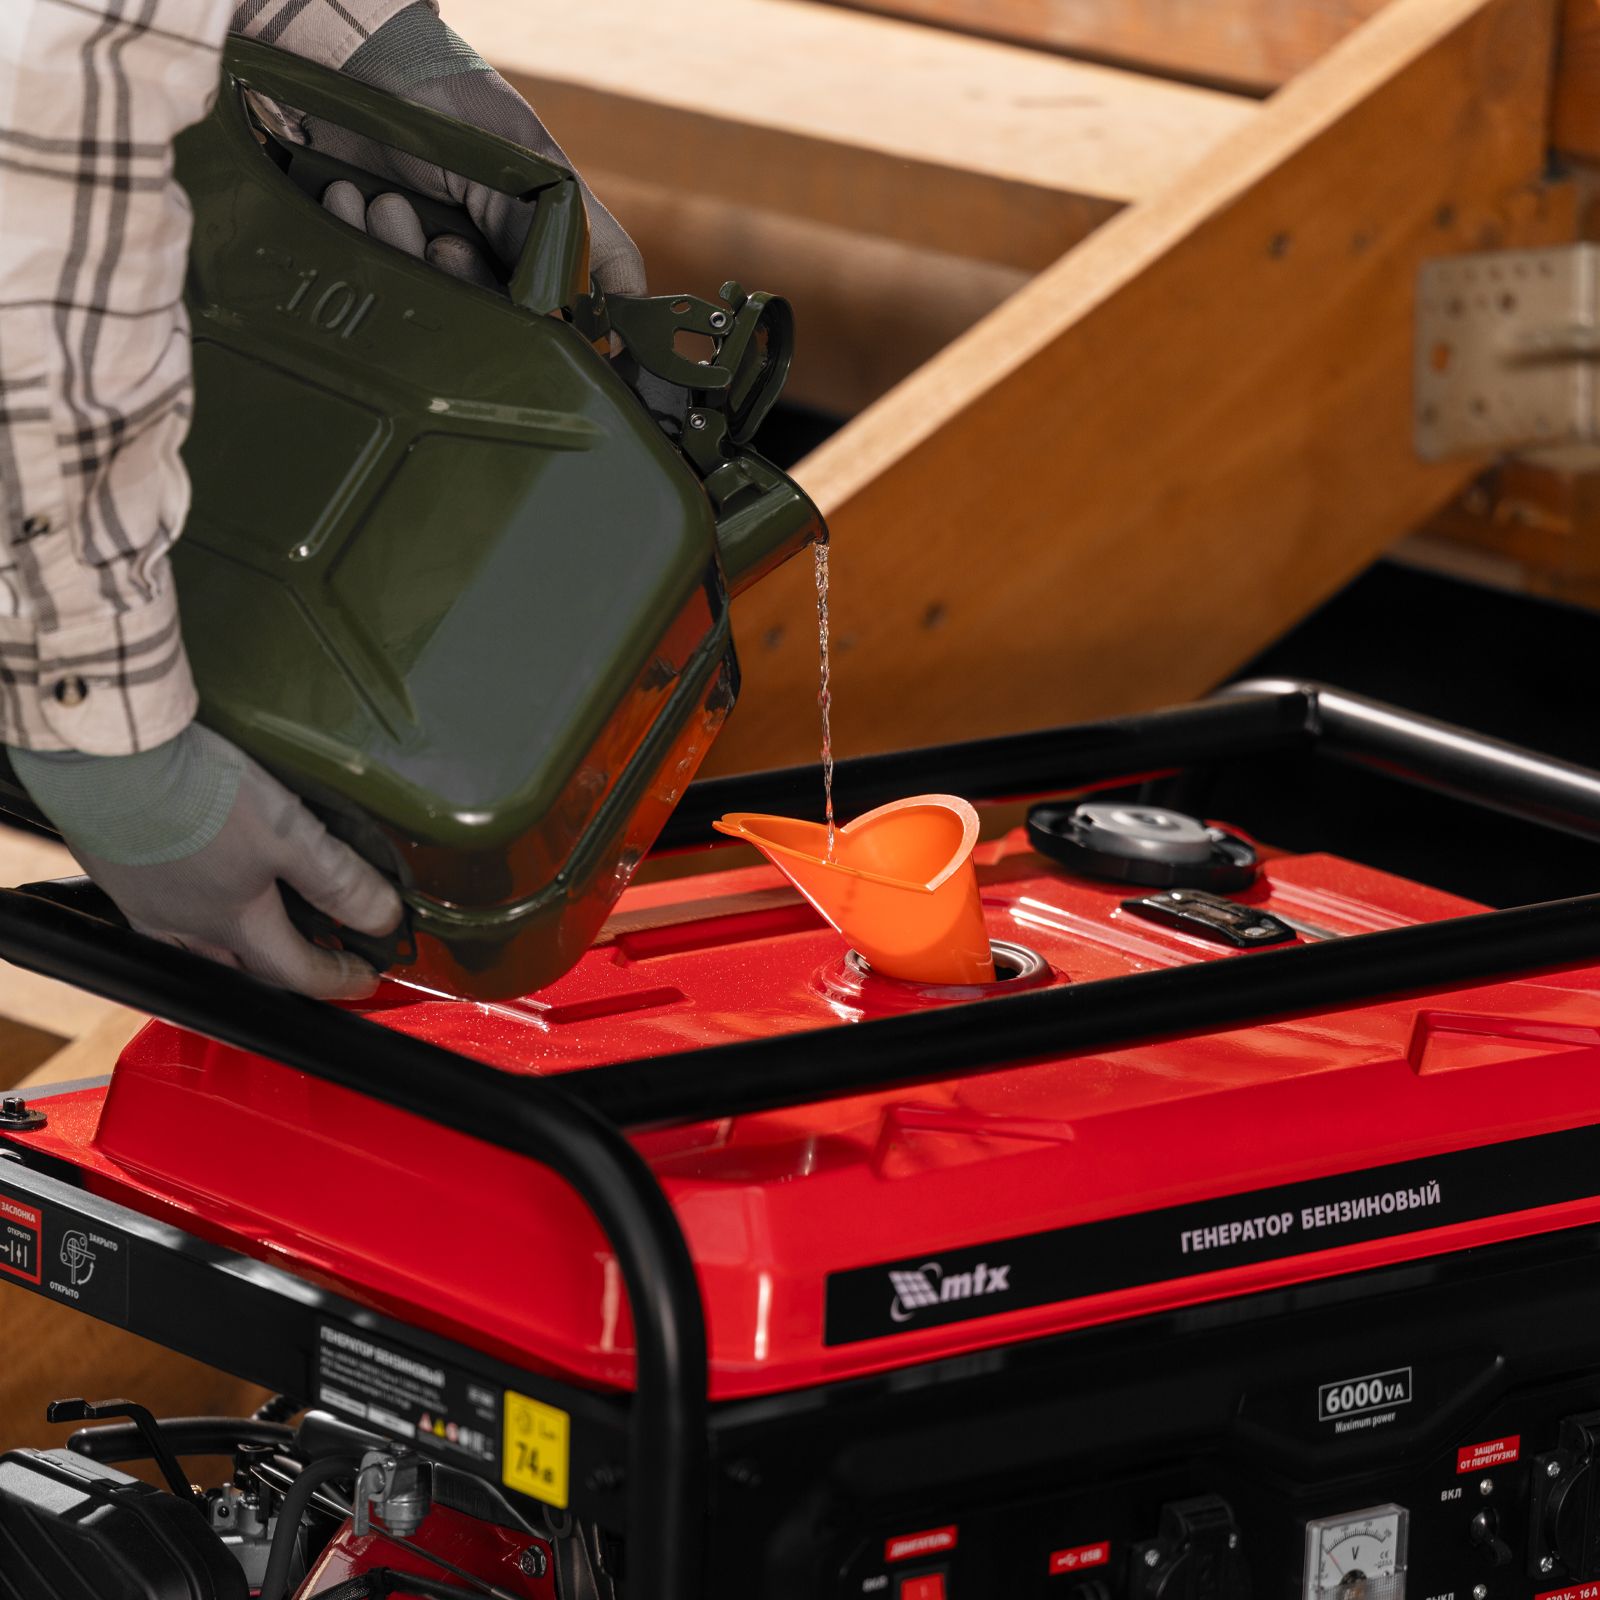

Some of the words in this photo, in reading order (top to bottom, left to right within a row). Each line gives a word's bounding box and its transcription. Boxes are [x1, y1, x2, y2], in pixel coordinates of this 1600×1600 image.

[0, 1201, 36, 1223] ЗАСЛОНКА
[1180, 1211, 1294, 1254] ГЕНЕРАТОР
[1301, 1180, 1441, 1230] БЕНЗИНОВЫЙ
[7, 1226, 31, 1241] ОТКРЫТО
[88, 1232, 118, 1252] ЗАКРЫТО
[49, 1281, 79, 1300] ОТКРЫТО
[938, 1262, 1011, 1302] mtx
[1335, 1416, 1371, 1434] Maximum
[1372, 1410, 1396, 1429] power
[515, 1440, 539, 1477] 74
[1474, 1441, 1504, 1457] ЗАЩИТА
[1460, 1460, 1471, 1470] ОТ
[1471, 1449, 1517, 1468] ПЕРЕГРУЗКИ
[1440, 1487, 1462, 1502] ВКЛ
[1080, 1548, 1102, 1563] USB
[1351, 1545, 1360, 1561] V
[1579, 1588, 1590, 1599] 16
[1591, 1586, 1598, 1597] A
